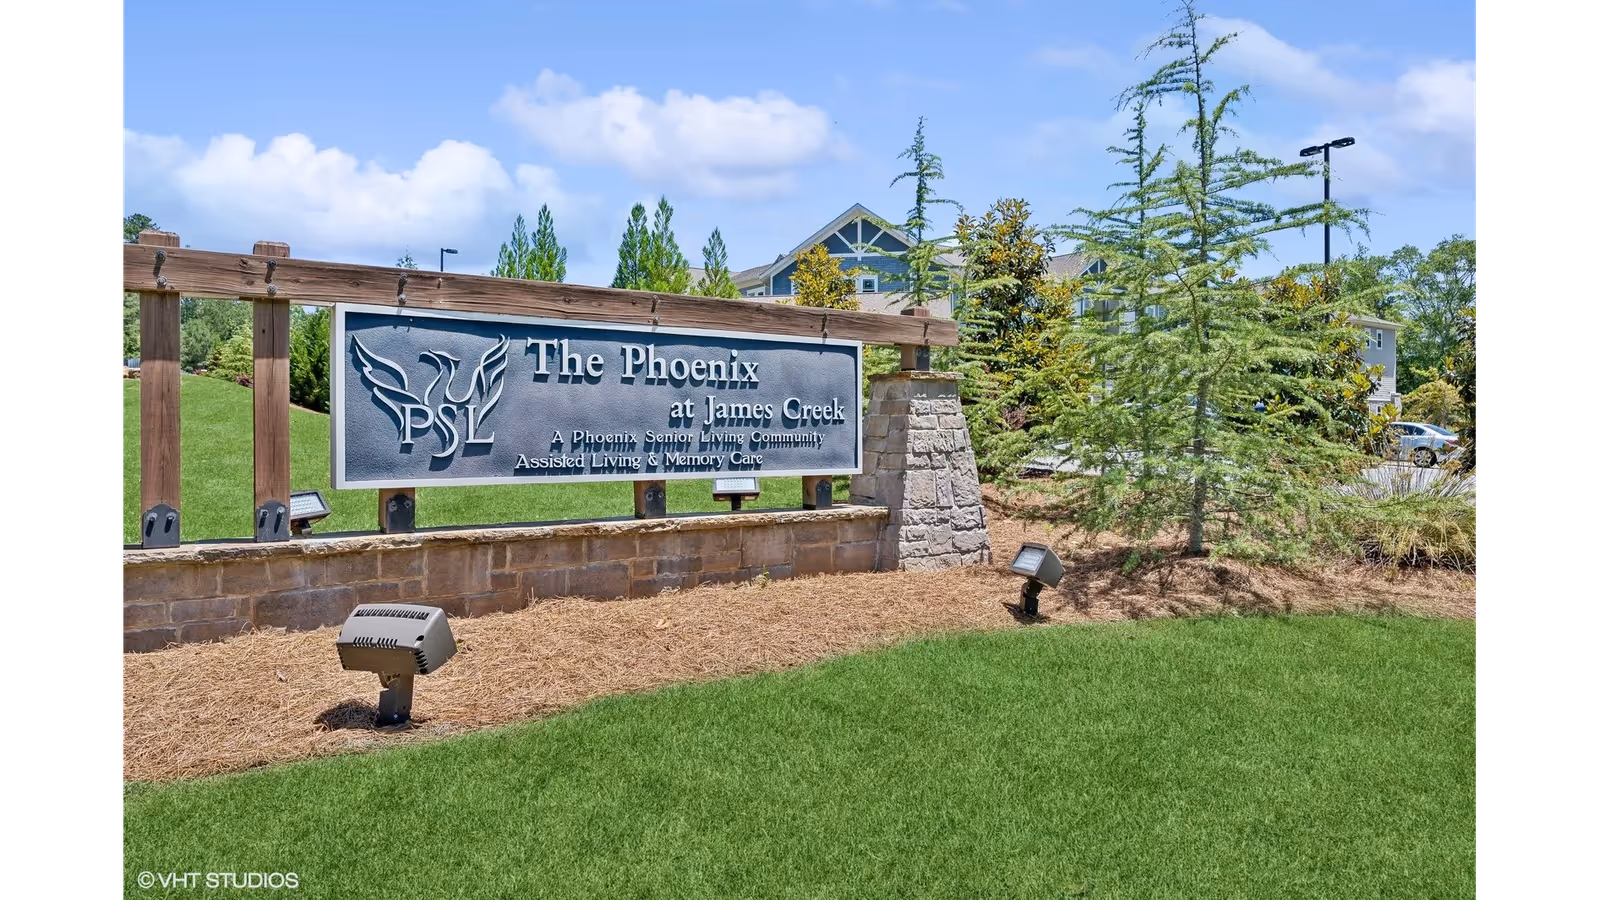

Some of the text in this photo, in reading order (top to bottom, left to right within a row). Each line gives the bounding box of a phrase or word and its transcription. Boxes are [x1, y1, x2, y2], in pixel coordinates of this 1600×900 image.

[526, 337, 760, 383] The Phoenix
[670, 395, 845, 425] at James Creek
[401, 404, 495, 458] PSL
[551, 430, 826, 446] A Phoenix Senior Living Community
[514, 452, 763, 469] Assisted Living & Memory Care
